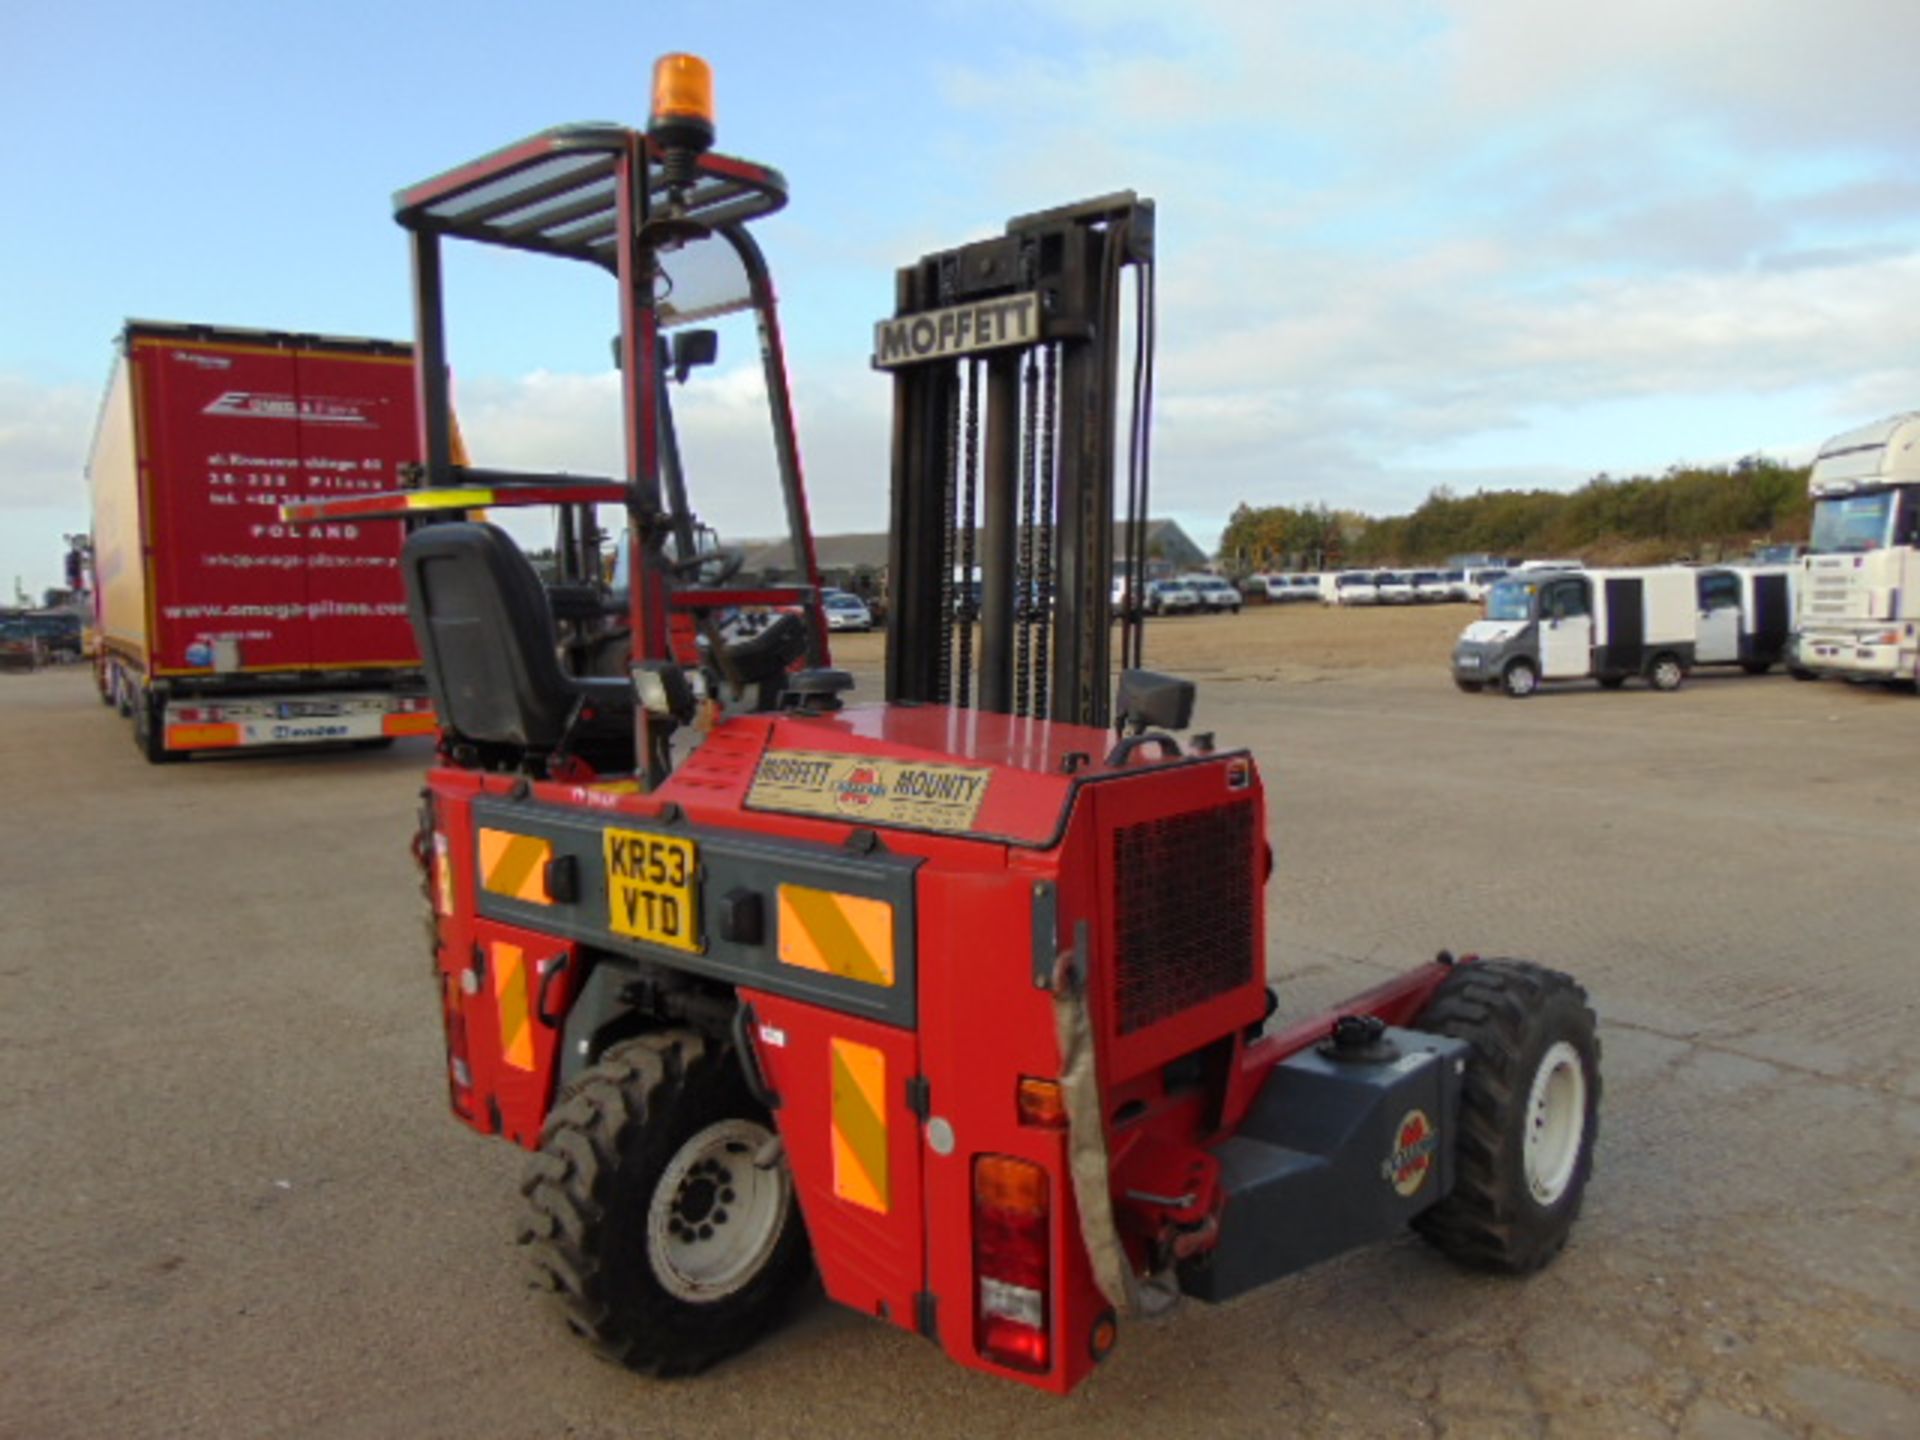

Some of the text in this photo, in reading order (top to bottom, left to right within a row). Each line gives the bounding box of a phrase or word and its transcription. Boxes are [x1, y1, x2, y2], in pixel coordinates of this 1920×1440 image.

[881, 299, 1033, 361] MOFFETT
[252, 524, 359, 539] POLAND
[757, 757, 832, 786] MOFFETT
[893, 769, 982, 802] MOUNTY
[611, 836, 685, 889] KR53
[623, 886, 680, 937] VTD
